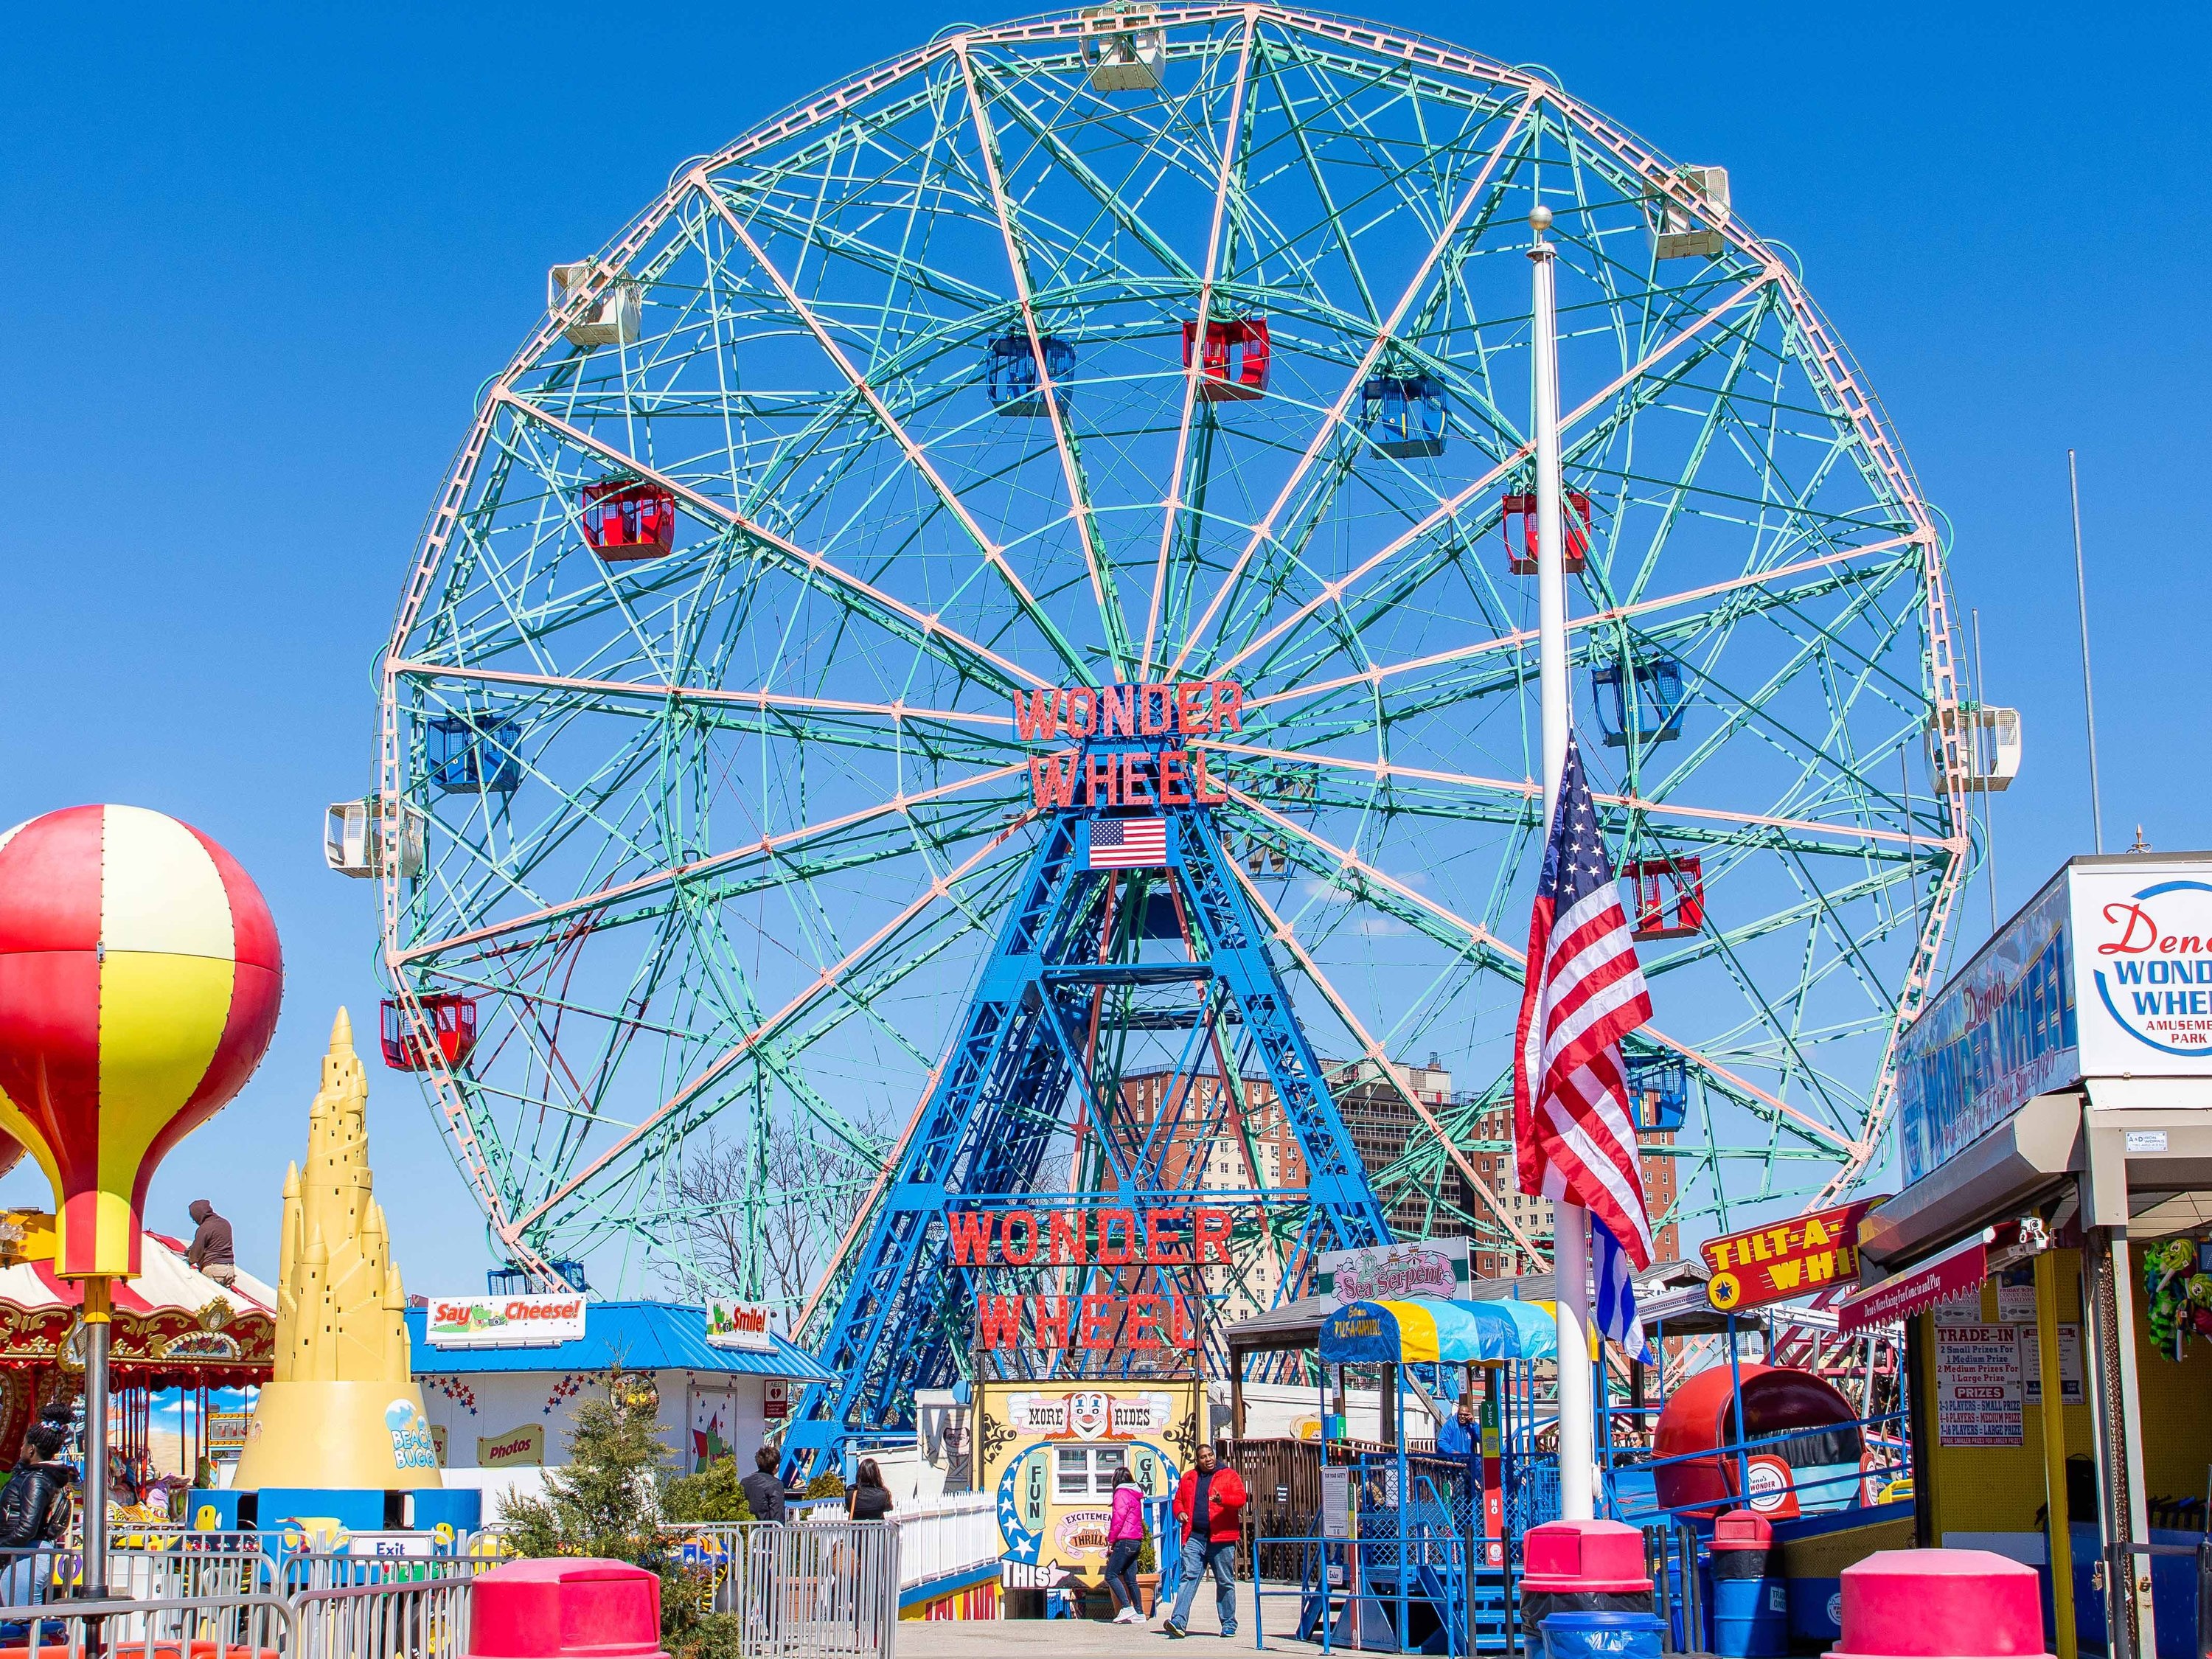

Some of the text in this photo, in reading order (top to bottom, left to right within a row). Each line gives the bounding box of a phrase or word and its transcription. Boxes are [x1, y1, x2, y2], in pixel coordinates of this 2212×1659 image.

[1012, 681, 1242, 741] WONDER
[1029, 751, 1228, 808] WHEEL
[1964, 970, 2007, 1034] Deno's
[2131, 991, 2212, 1016] WHE
[2171, 1033, 2208, 1043] PARK
[2015, 1066, 2035, 1097] SINCE
[2037, 1045, 2055, 1083] 1920
[948, 1210, 1232, 1266] WONDER
[1343, 1264, 1444, 1298] Sea Serpent
[1897, 1289, 1905, 1303] Fun
[1905, 1285, 1916, 1299] Come
[1916, 1282, 1921, 1295] in
[1922, 1276, 1930, 1293] and
[1930, 1273, 1941, 1291] Play
[434, 1300, 582, 1326] Say Cheese!
[733, 1306, 767, 1334] Smile!
[978, 1293, 1196, 1349] WHEEL
[1938, 1329, 2014, 1341] TRADE-IN
[1958, 1374, 1982, 1383] Large
[1958, 1388, 2001, 1397] PRIZES
[1029, 1408, 1150, 1426] MORE RIDES
[1950, 1401, 1976, 1411] PLAYERS
[1981, 1401, 2003, 1411] SMALL
[2003, 1401, 2021, 1411] PRIZE
[1950, 1413, 1975, 1423] PLAYERS
[1980, 1413, 2003, 1423] MEDIUM
[2003, 1413, 2021, 1423] PRIZE
[1952, 1425, 1978, 1436] PLAYERS
[1983, 1425, 2003, 1436] LARGE
[2004, 1425, 2022, 1436] PRIZE
[490, 1439, 532, 1459] Photos
[1139, 1458, 1152, 1500] GAM
[1750, 1481, 1775, 1491] WONDER
[1030, 1466, 1042, 1519] FUN
[1491, 1498, 1498, 1514] NO
[376, 1542, 406, 1556] Exit
[1073, 1534, 1108, 1547] THRILLS
[1001, 1558, 1050, 1587] THIS
